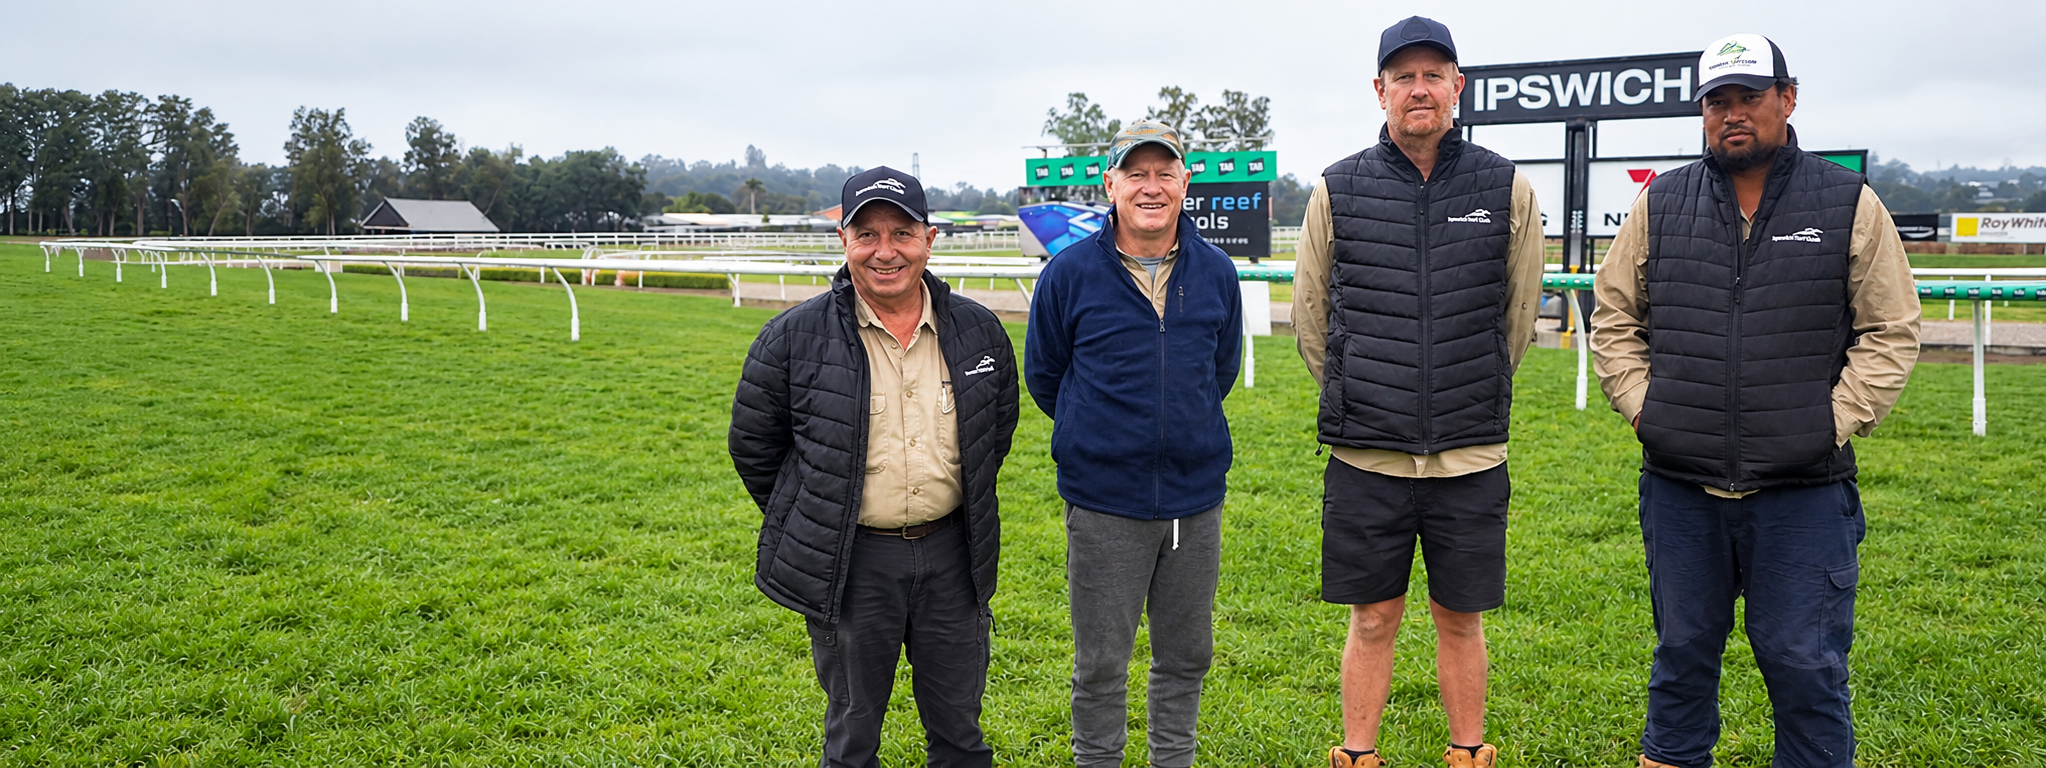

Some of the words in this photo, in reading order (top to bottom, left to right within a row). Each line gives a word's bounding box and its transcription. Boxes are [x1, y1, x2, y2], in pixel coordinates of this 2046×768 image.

[1474, 66, 1692, 112] IPSWICH
[1219, 162, 1235, 172] TAB
[1248, 162, 1264, 172] TAB
[1182, 196, 1205, 211] er
[1211, 192, 1262, 211] reef
[1191, 212, 1229, 230] ols
